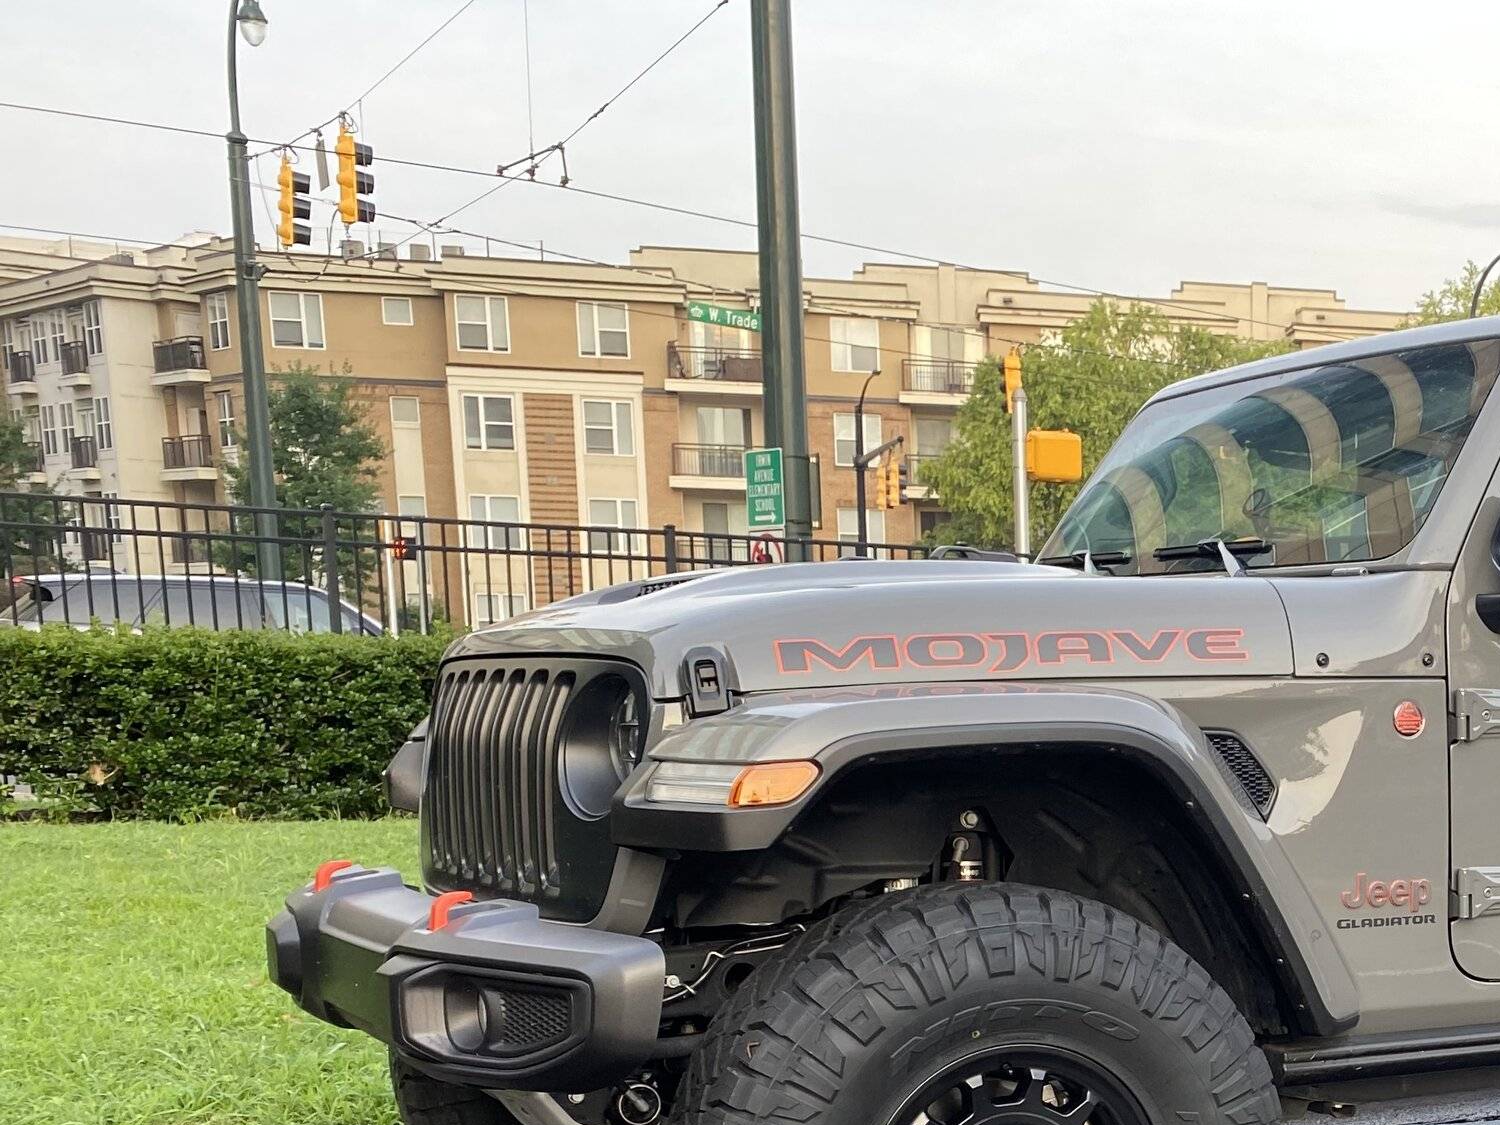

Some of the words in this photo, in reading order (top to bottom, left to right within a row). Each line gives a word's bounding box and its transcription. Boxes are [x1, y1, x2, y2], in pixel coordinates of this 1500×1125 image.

[709, 307, 720, 322] W.
[726, 311, 758, 329] Trade
[774, 628, 1249, 675] MOJAVE
[1341, 872, 1431, 913] Jeep
[1336, 914, 1436, 929] GLADIATOR
